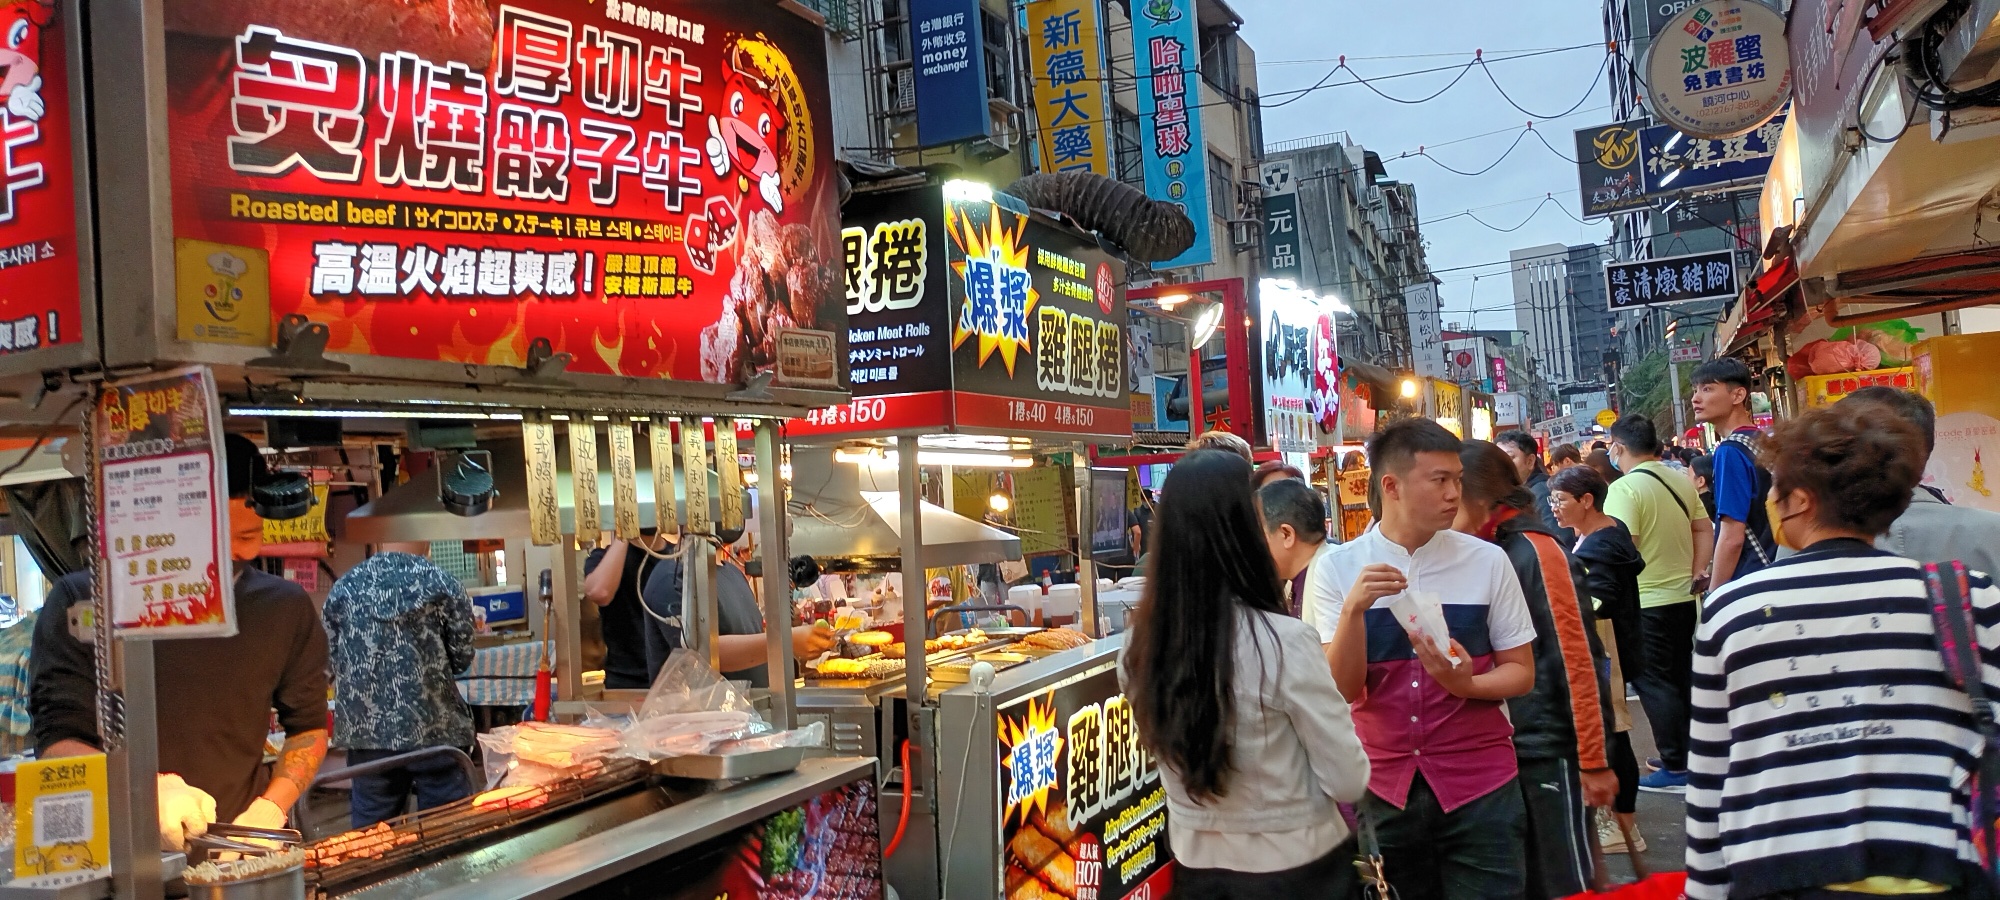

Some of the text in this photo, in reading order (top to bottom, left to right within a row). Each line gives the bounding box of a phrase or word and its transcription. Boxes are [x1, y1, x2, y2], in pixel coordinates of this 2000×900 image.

[920, 12, 964, 33] 台灣銀行
[922, 30, 966, 51] 外幣收兌
[1681, 34, 1763, 73] 波羅蜜
[498, 4, 703, 128] 厚切牛
[922, 46, 967, 65] money
[923, 59, 969, 76] exchanger
[1042, 9, 1092, 172] 新德大藥
[1684, 62, 1765, 92] 免費書坊
[227, 25, 487, 193] 炙燒
[1151, 38, 1191, 155] 哈啦星球
[494, 104, 702, 213] 骰子牛
[231, 193, 397, 226] Roasted beef
[415, 207, 563, 236] サイコロステ ステーキ
[574, 218, 684, 243] 큐브 스테 스테이크
[41, 241, 55, 259] 소
[605, 253, 677, 275] 嚴選頂級
[604, 275, 693, 296] 安格斯黑牛
[1097, 273, 1115, 302] HOT
[1611, 268, 1632, 305] 連家
[1633, 261, 1730, 298] 清燉豬腳
[963, 254, 1031, 339] 爆漿
[877, 325, 903, 340] Meat
[904, 322, 930, 337] Rolls
[849, 344, 925, 363] チキンミートロール
[1037, 306, 1121, 398] 雞腿捲
[850, 368, 868, 383] 치킨
[1784, 731, 1834, 748] Maison
[1008, 727, 1059, 804] 爆漿
[1067, 693, 1160, 832] 雞腿
[1075, 860, 1102, 886] HOT
